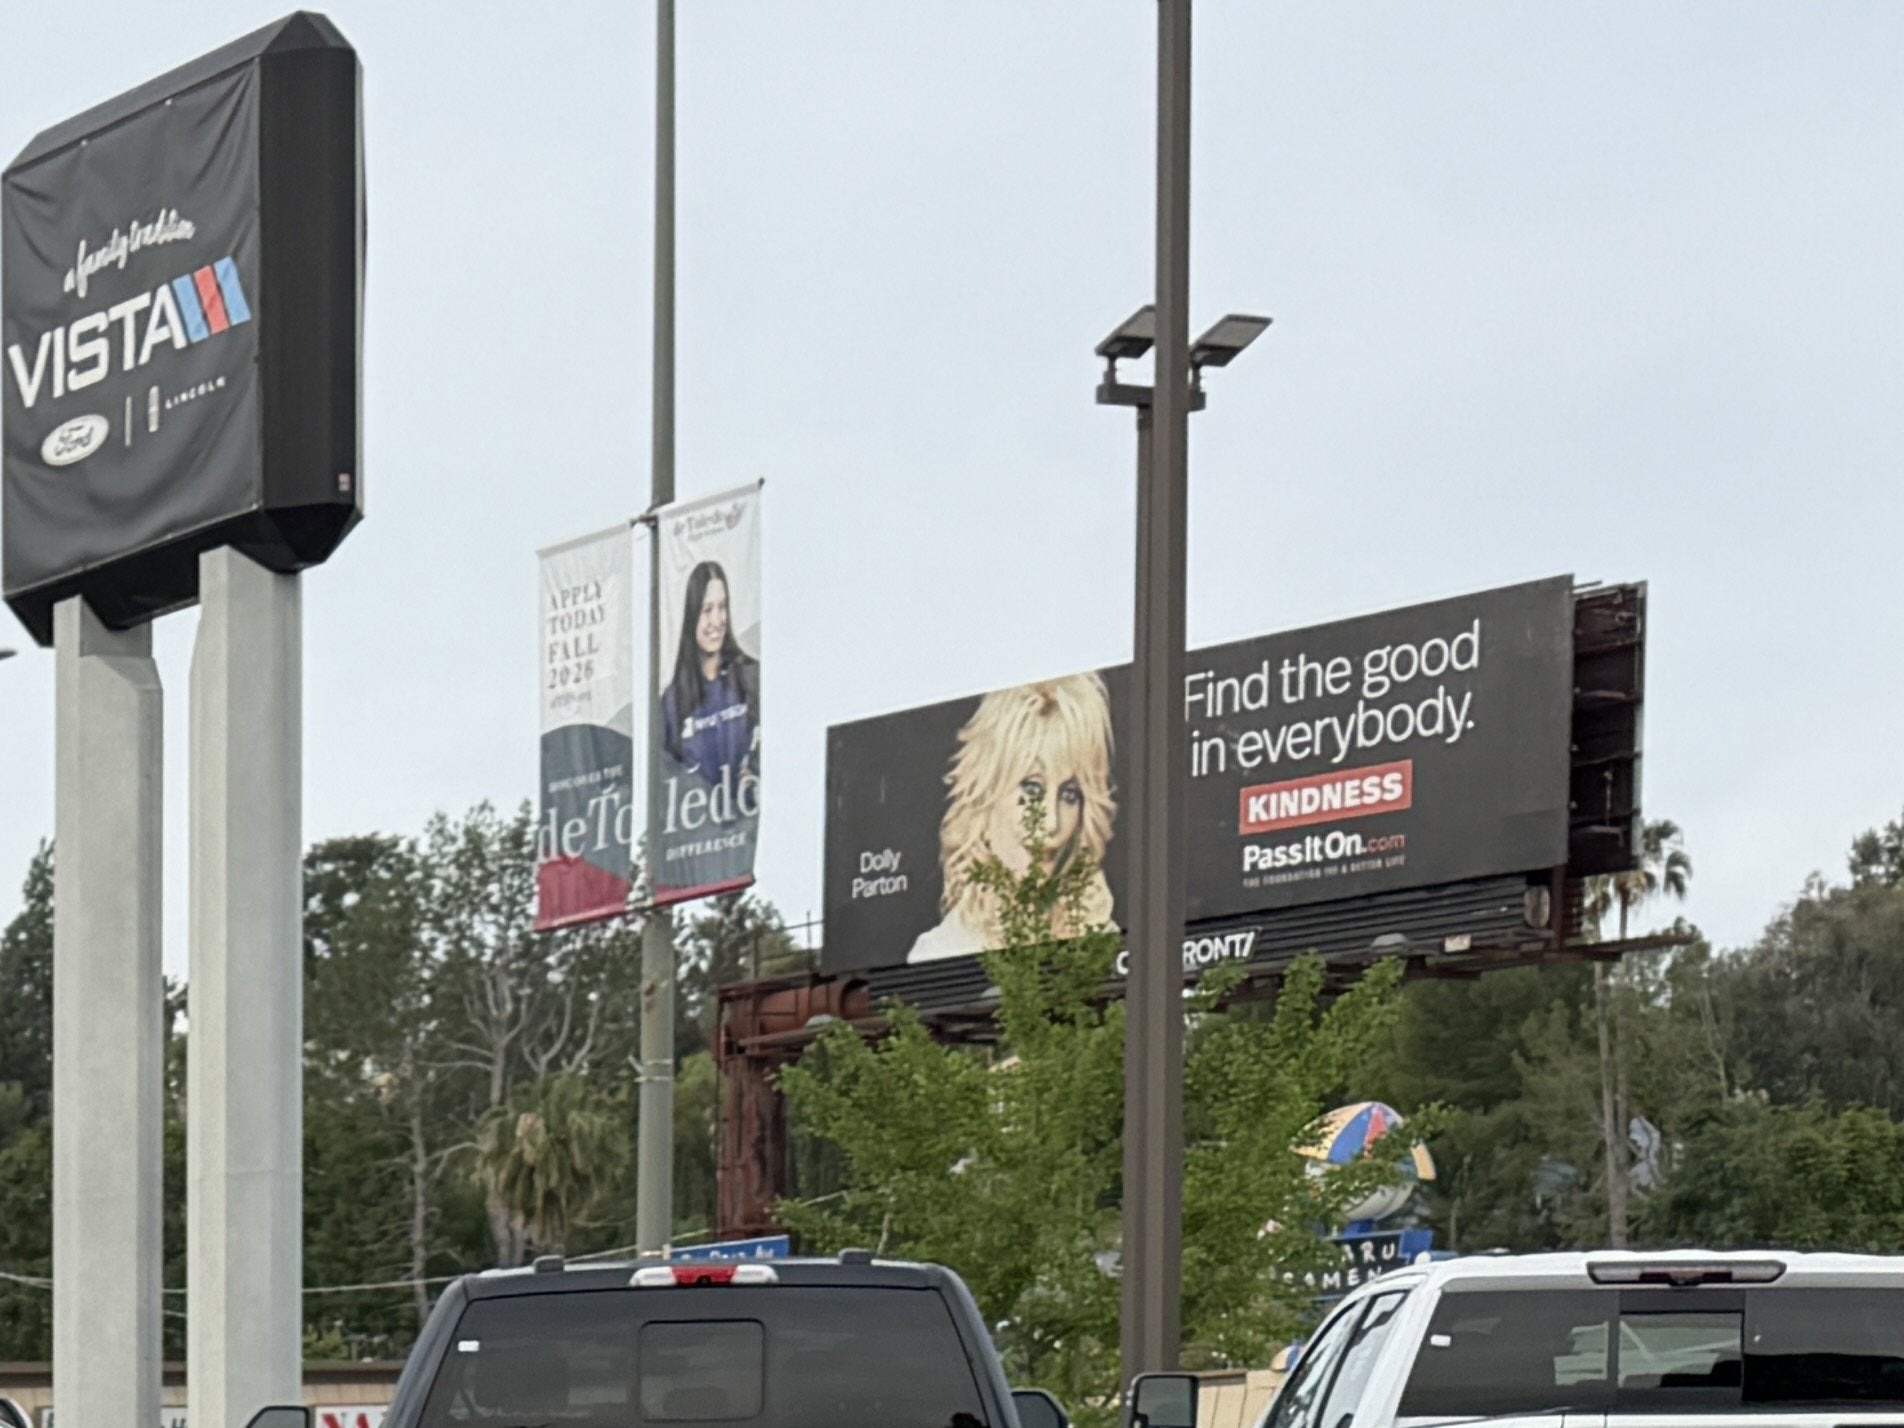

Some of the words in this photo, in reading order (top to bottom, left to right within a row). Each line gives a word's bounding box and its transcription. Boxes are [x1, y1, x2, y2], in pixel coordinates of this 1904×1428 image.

[8, 283, 188, 408] VISTA
[165, 376, 226, 410] LINCOLN
[1185, 660, 1269, 722] Find
[1280, 653, 1352, 704] the
[1363, 618, 1480, 699] good
[1192, 730, 1226, 777] in
[1237, 685, 1475, 768] everybody.
[1248, 772, 1404, 824] KINDNESS
[852, 874, 908, 899] Parton
[860, 848, 902, 874] Dolly
